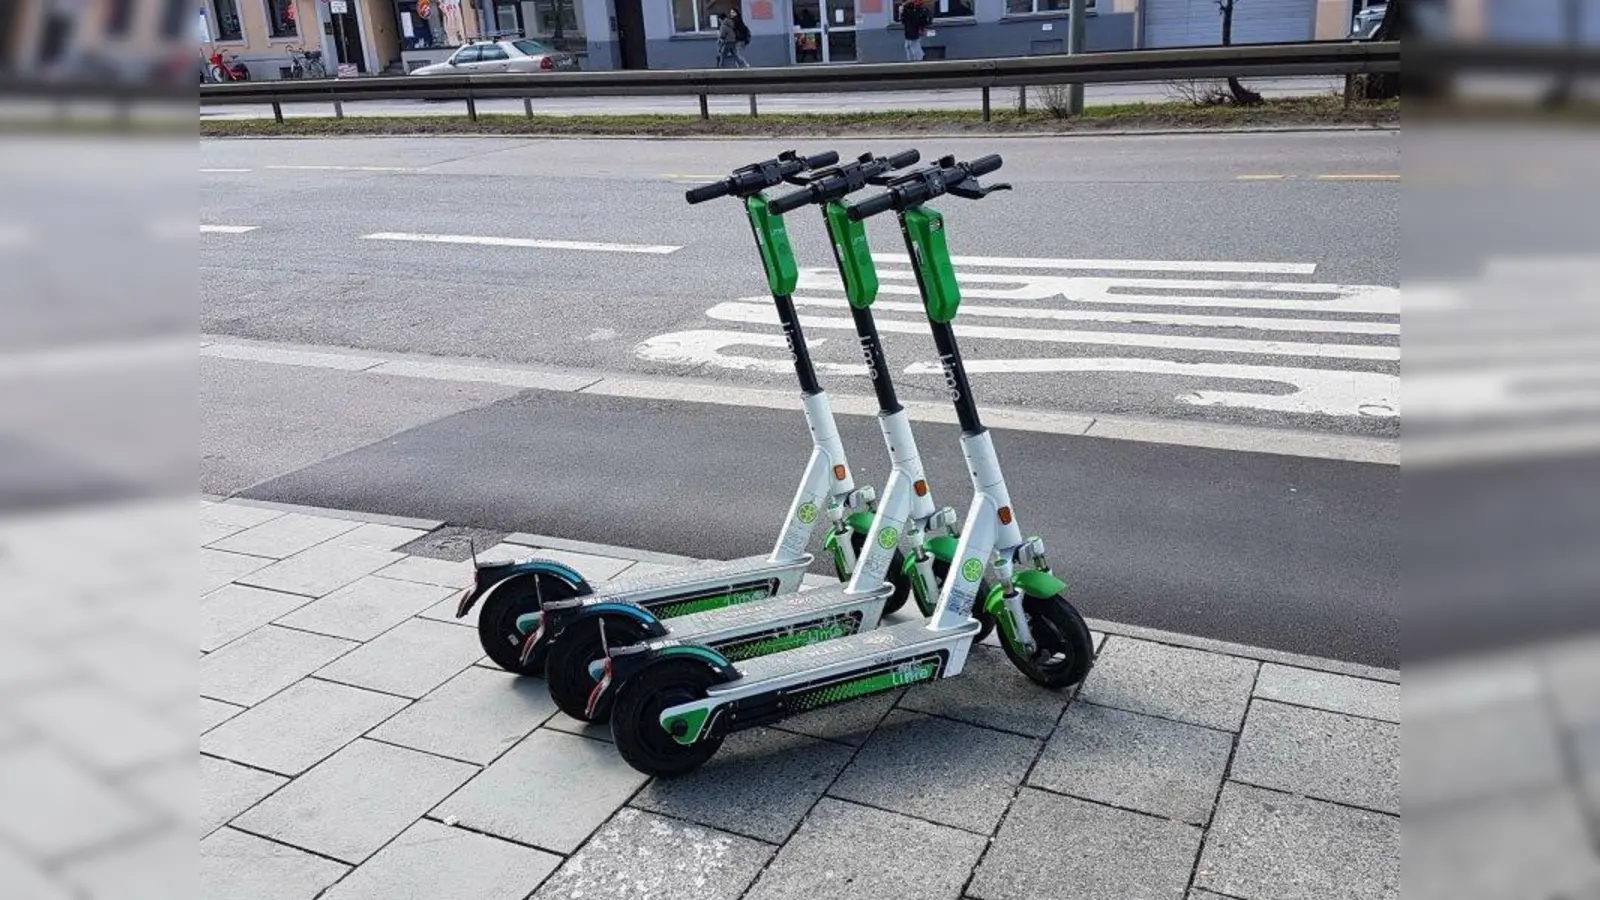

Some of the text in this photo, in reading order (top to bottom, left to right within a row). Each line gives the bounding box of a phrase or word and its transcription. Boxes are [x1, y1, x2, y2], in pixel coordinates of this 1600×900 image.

[781, 321, 799, 364] Lime
[858, 335, 880, 381] Lime
[939, 353, 961, 402] Lime
[892, 668, 929, 686] Lime
